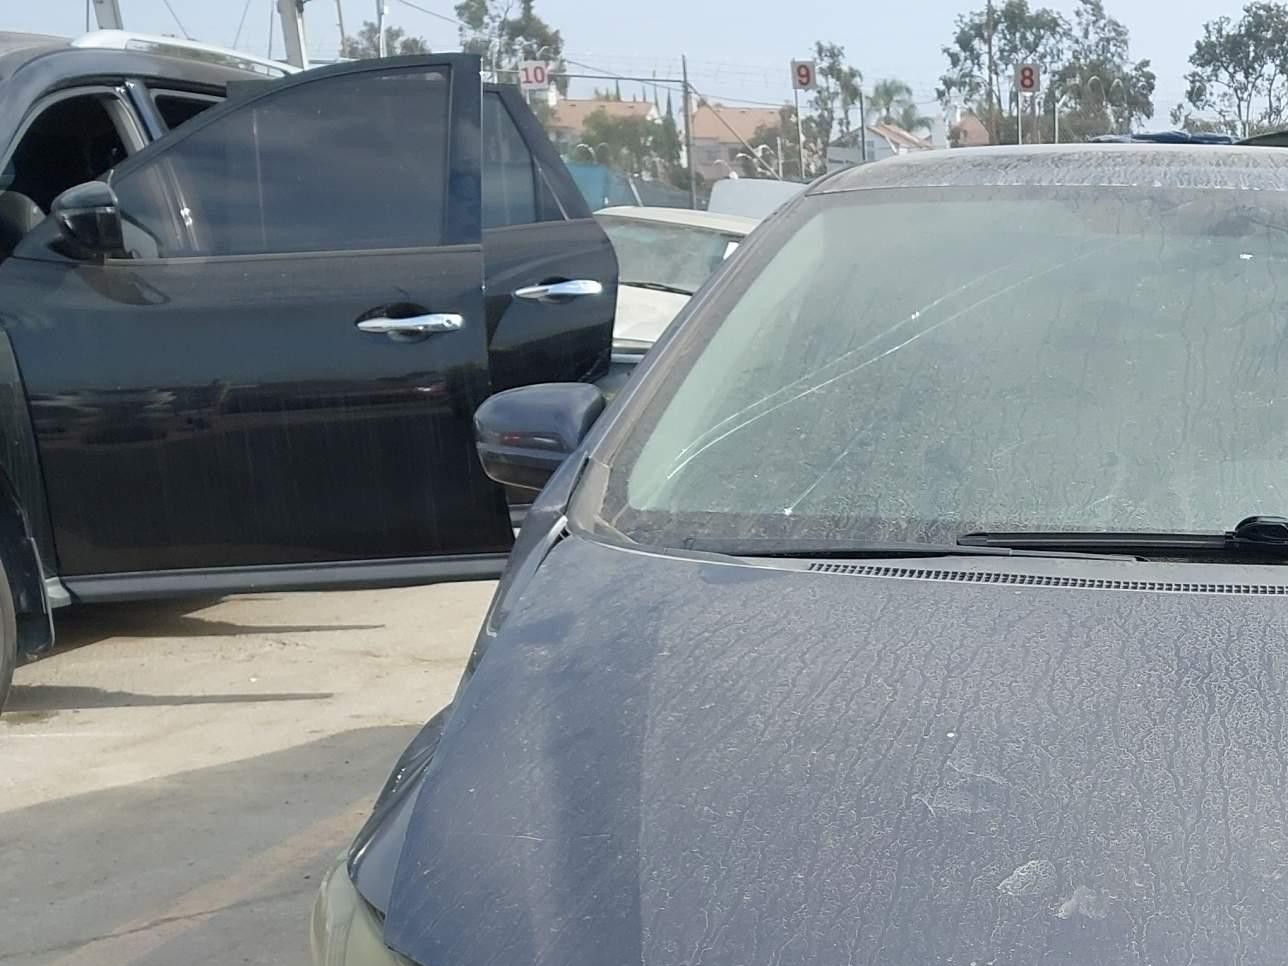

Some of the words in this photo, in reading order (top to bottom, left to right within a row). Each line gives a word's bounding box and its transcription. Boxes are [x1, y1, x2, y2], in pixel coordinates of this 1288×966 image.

[521, 66, 545, 84] 10
[796, 64, 810, 86] 9
[1020, 67, 1034, 89] 8
